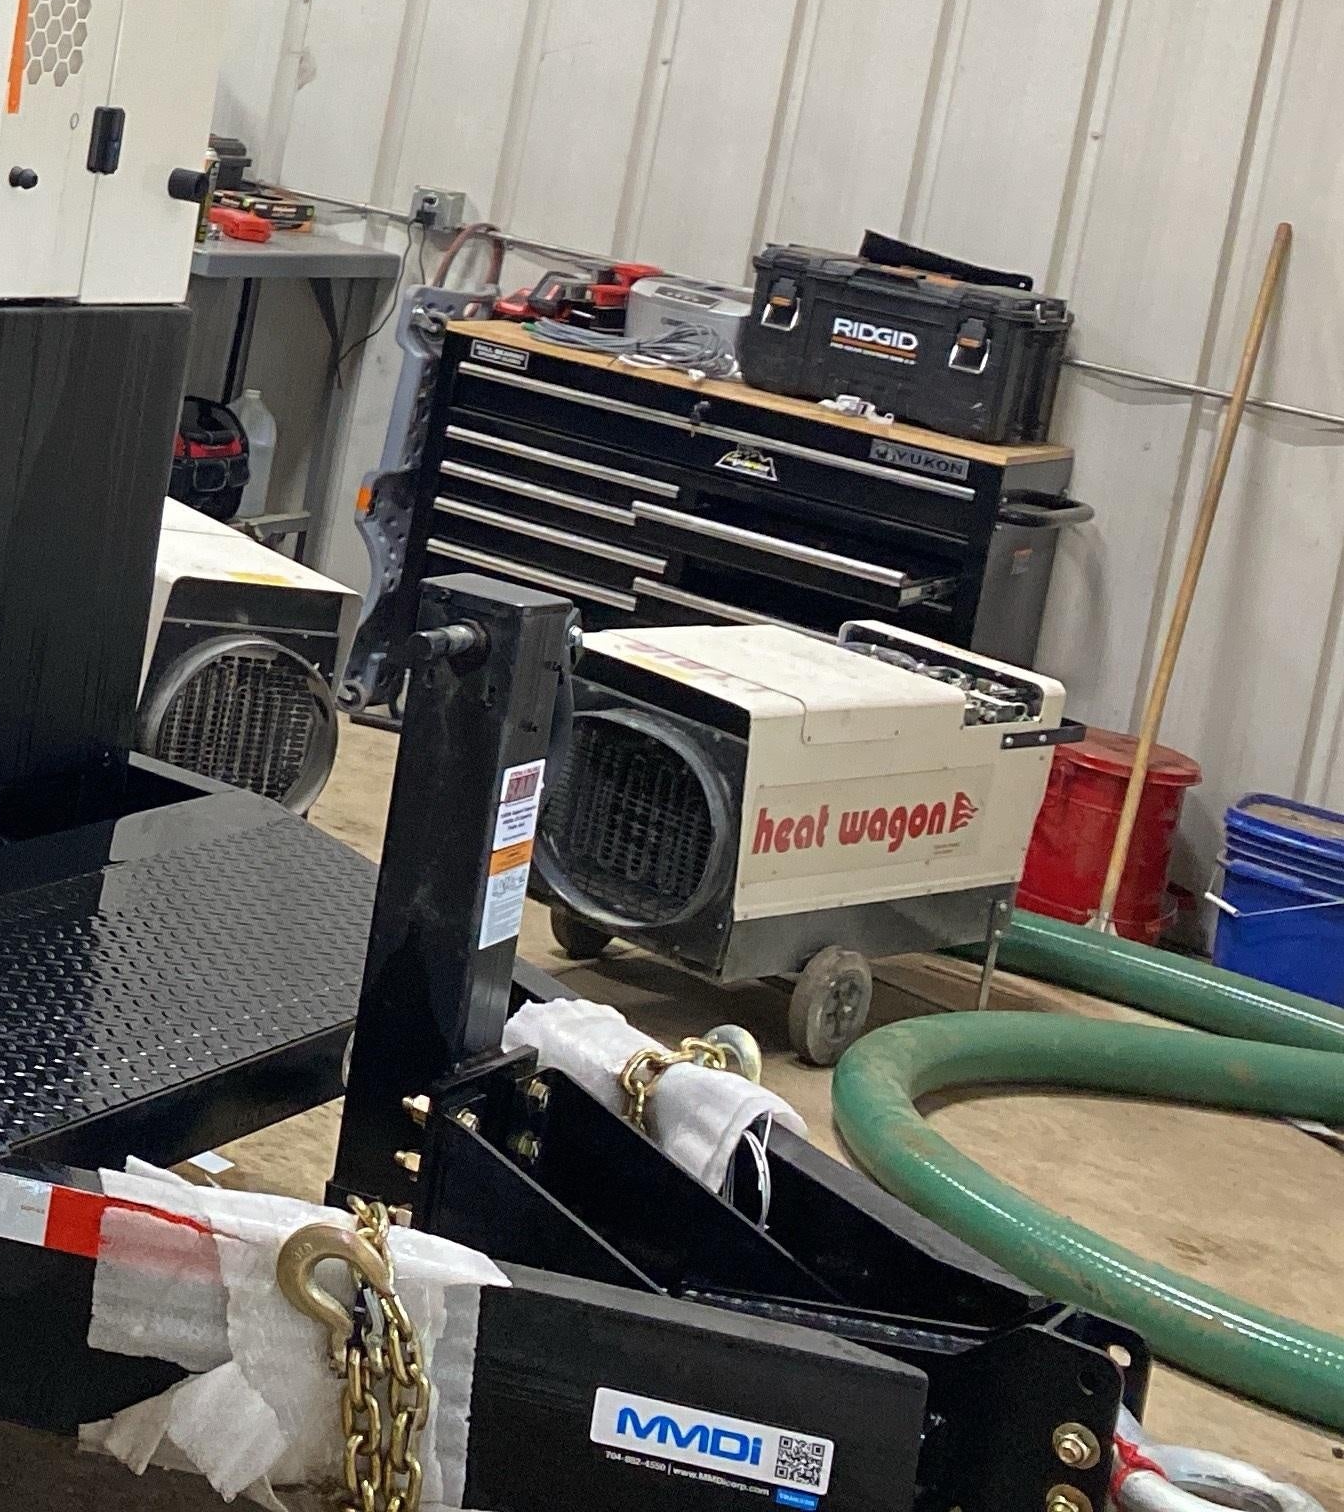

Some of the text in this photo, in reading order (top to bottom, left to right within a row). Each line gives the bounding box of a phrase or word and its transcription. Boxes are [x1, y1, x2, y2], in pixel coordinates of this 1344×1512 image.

[832, 317, 919, 351] RIDGID
[896, 450, 964, 476] YUKON
[751, 802, 947, 855] heat wagon
